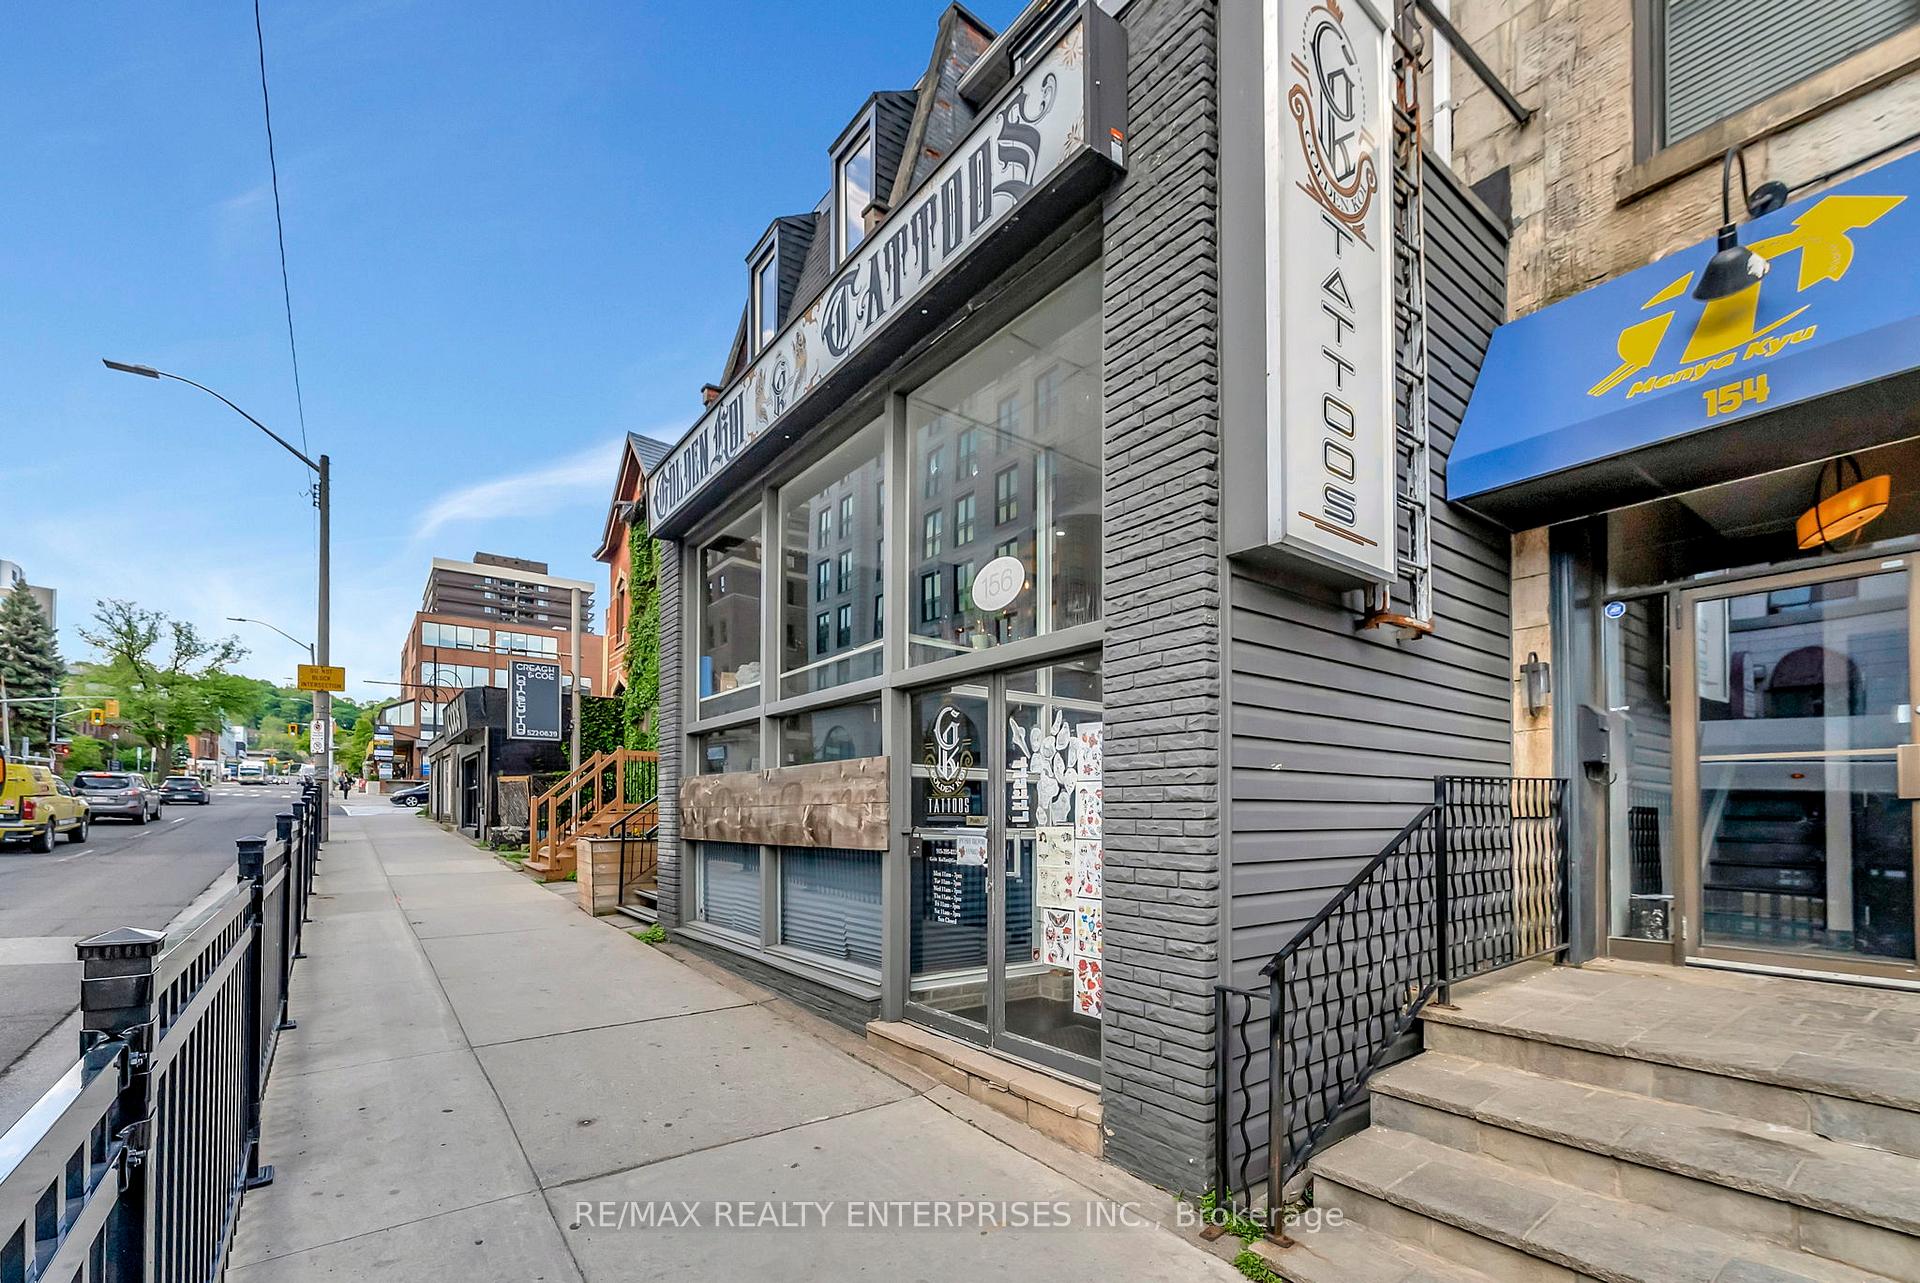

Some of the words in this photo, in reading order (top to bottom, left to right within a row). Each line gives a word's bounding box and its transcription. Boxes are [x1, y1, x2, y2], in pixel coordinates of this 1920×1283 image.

[821, 72, 1057, 357] TATTOOS
[1321, 209, 1357, 528] TATTOOS
[1626, 352, 1737, 399] Menya
[1743, 323, 1818, 360] Kyu
[1702, 373, 1770, 417] 154
[981, 568, 1013, 600] 156
[516, 663, 555, 673] CREAGH
[930, 769, 955, 793] GOLDEN
[928, 797, 970, 813] TATTOOS
